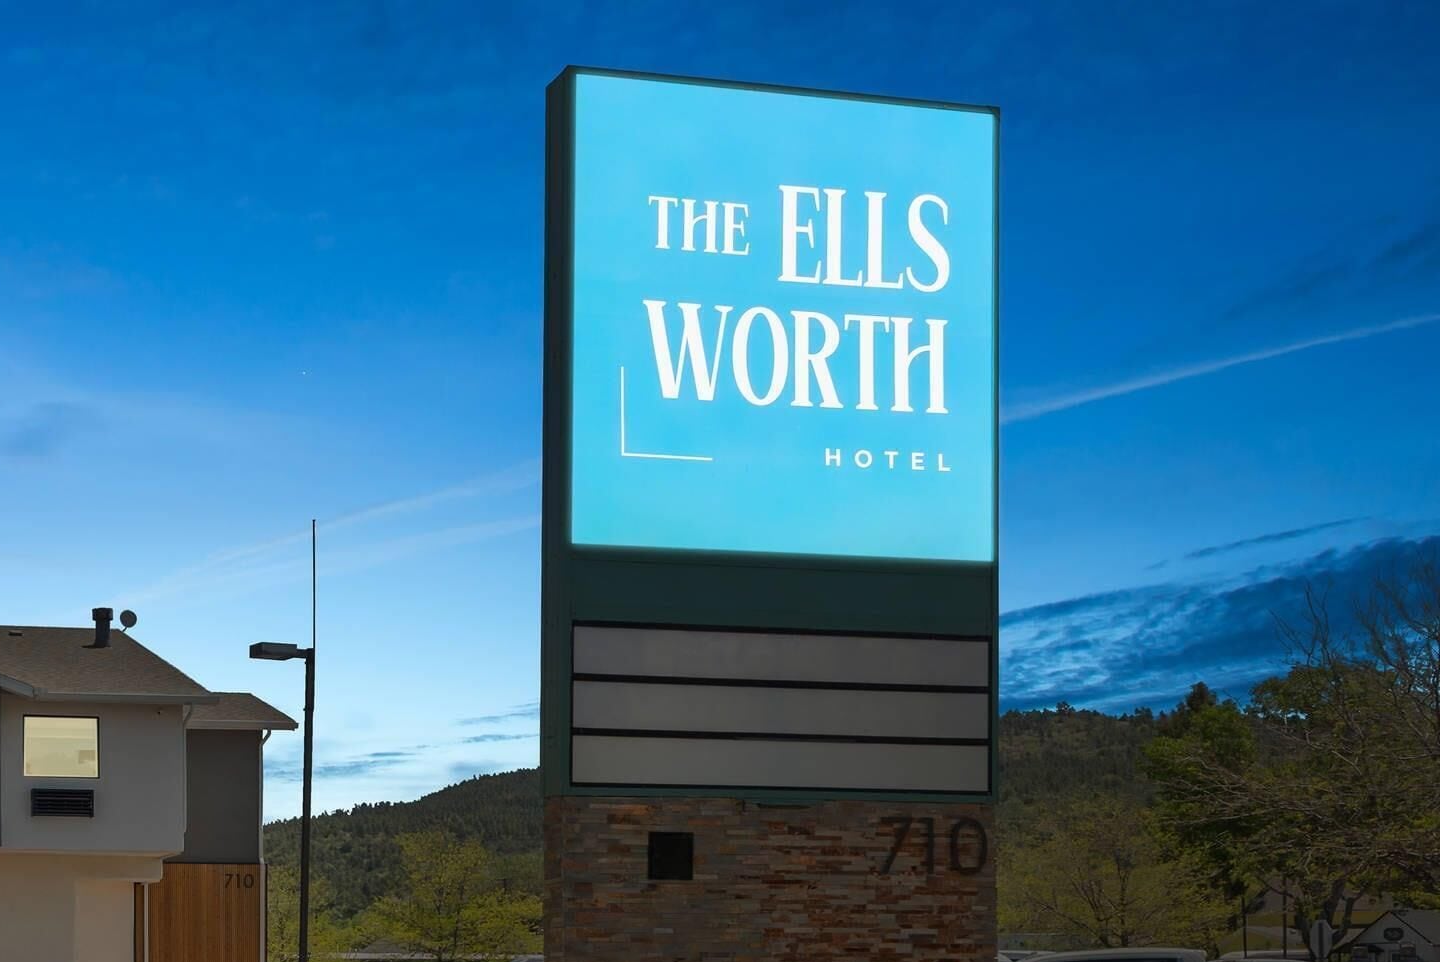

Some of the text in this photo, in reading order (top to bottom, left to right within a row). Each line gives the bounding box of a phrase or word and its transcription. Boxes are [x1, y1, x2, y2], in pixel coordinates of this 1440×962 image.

[648, 184, 951, 293] THE ELLS
[643, 299, 949, 415] WORTH
[825, 447, 952, 472] HOTEL
[878, 815, 989, 877] 710
[224, 873, 254, 889] 710
